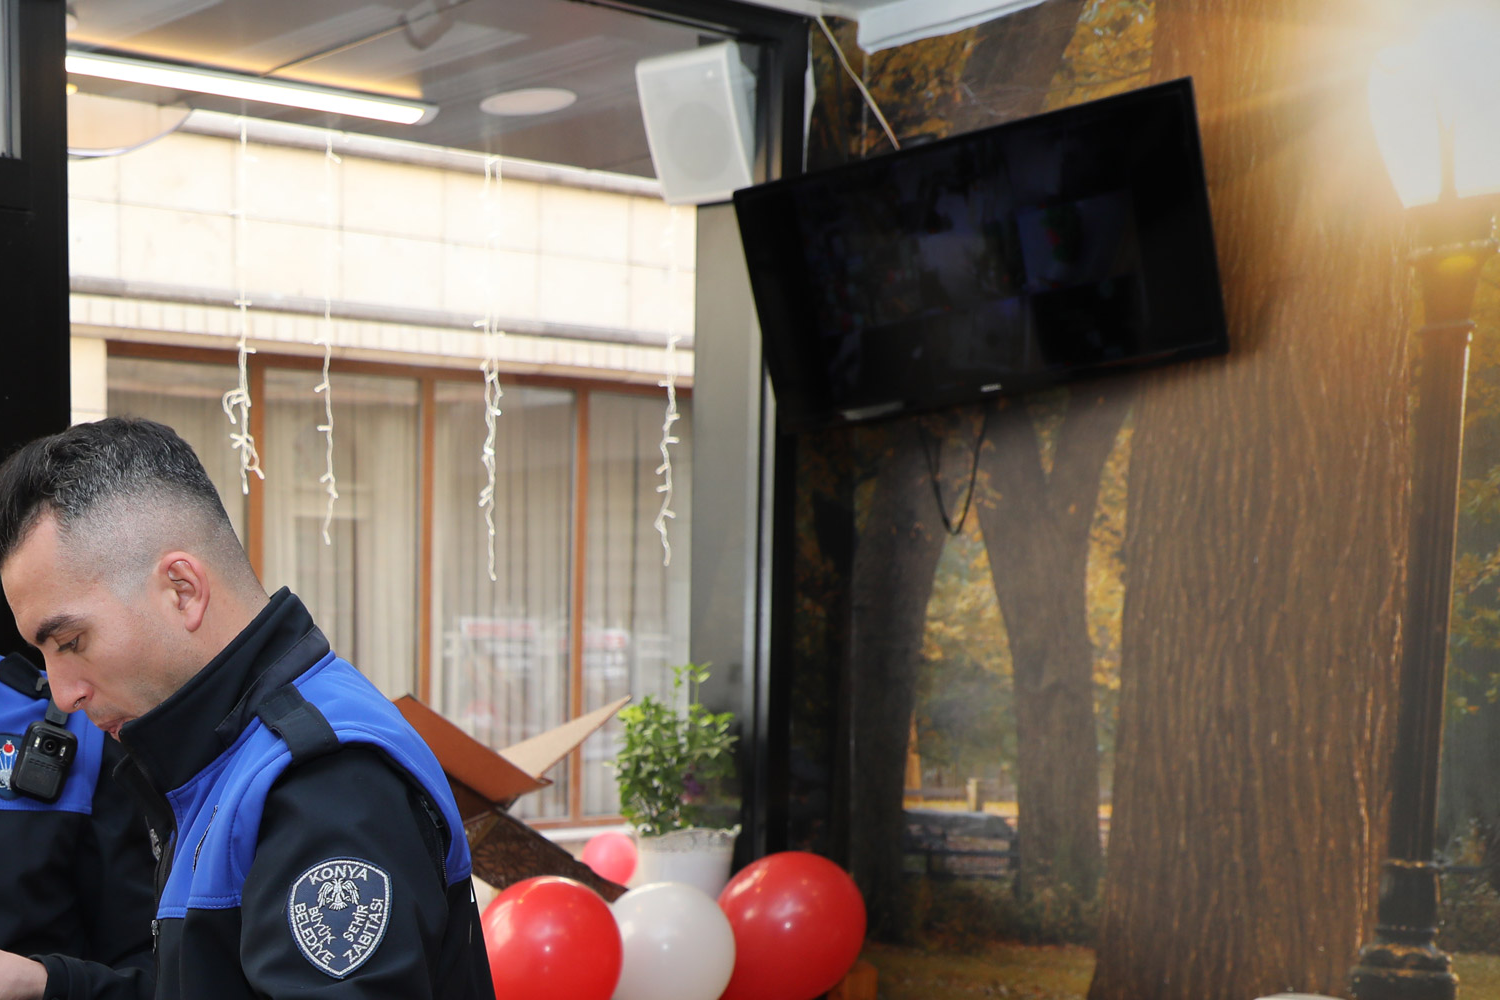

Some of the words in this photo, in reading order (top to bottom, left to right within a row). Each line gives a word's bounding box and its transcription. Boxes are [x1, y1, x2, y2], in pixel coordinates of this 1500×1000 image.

[309, 865, 368, 885] KONYA
[295, 902, 336, 966] BELEDİYE
[342, 898, 384, 964] ZABITASI
[308, 906, 336, 945] BÜYÜK
